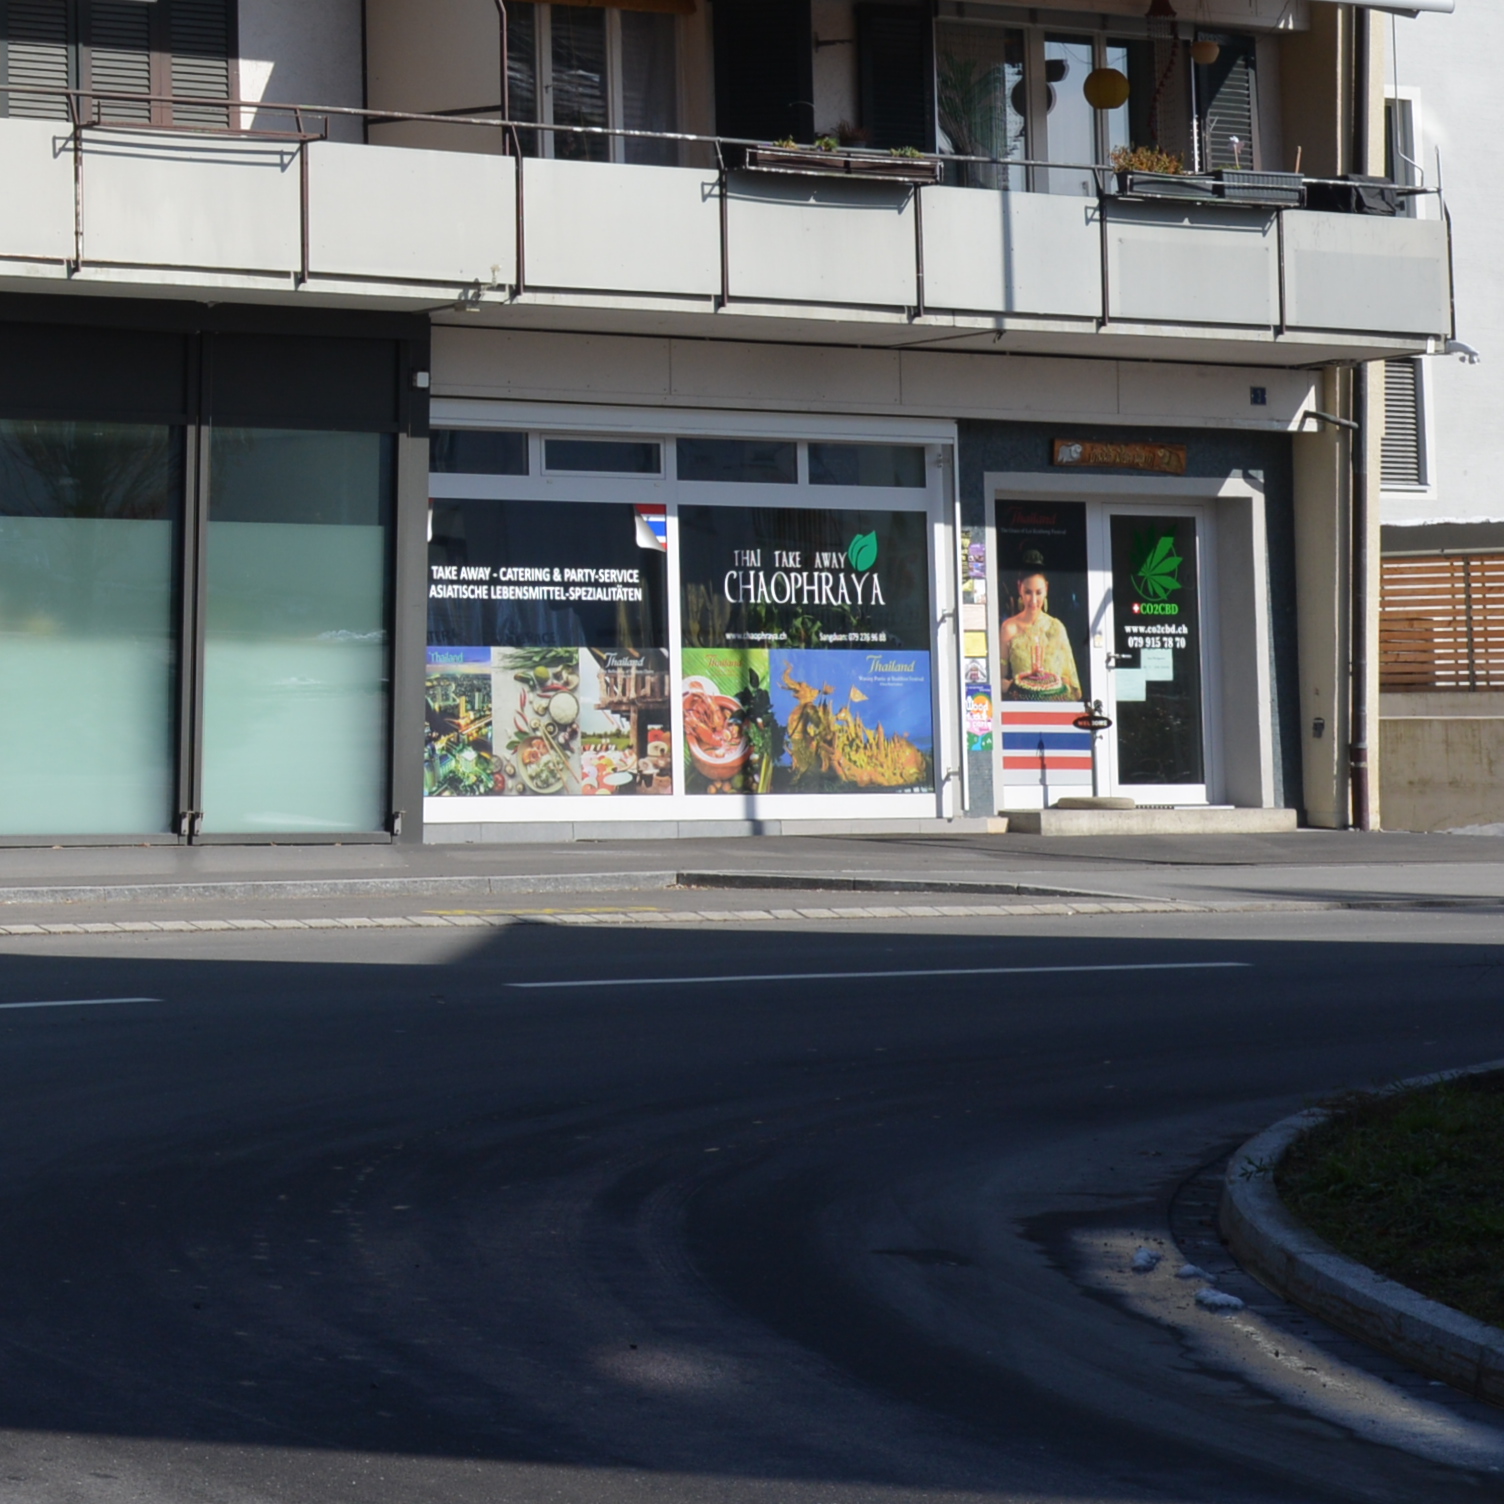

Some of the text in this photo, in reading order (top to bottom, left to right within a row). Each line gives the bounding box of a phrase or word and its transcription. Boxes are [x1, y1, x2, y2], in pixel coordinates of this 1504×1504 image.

[734, 549, 847, 569] THAI TAKE AWAY
[431, 566, 458, 580] TAKE
[460, 566, 491, 581] AWAY
[499, 567, 551, 582] CATERING
[553, 568, 562, 582] &
[564, 569, 640, 583] PARTY-SERVICE
[429, 585, 642, 602] ASIATISCHE LEBENSMITTEL-SPEZIALITÄTEN
[724, 570, 886, 606] CHAOPHRAYA
[1140, 603, 1179, 615] CO2CBD
[1124, 624, 1188, 634] www.co2cbd.ch
[1127, 637, 1186, 648] 079 915 78 70
[604, 652, 646, 668] Thailand
[866, 654, 917, 674] Thailand
